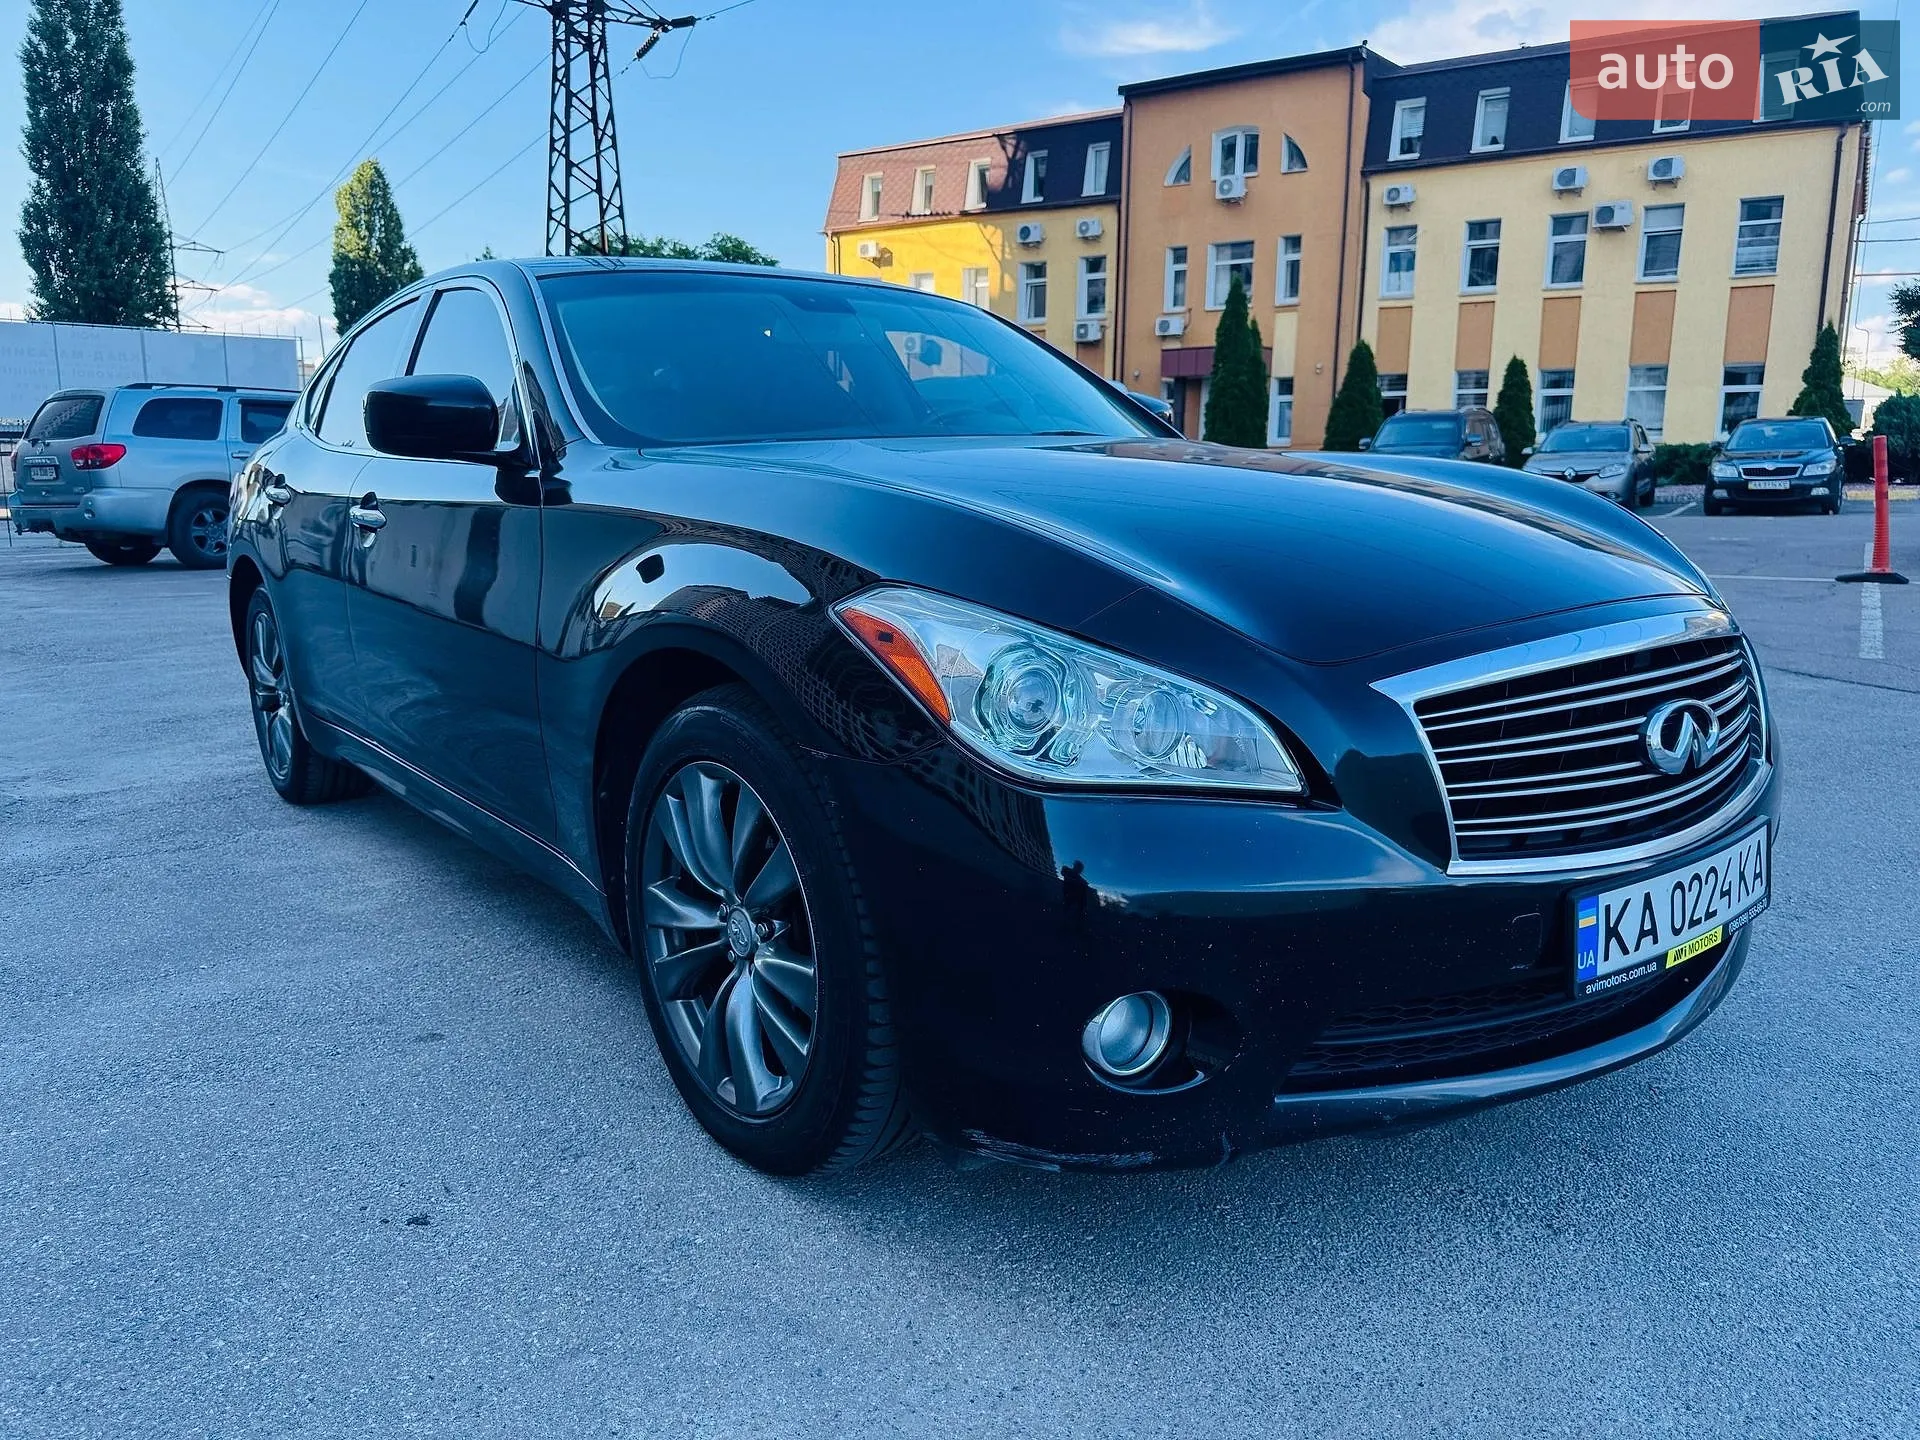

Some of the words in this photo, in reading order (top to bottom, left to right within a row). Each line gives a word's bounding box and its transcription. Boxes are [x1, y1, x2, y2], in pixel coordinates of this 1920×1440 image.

[1603, 891, 1659, 962] KA
[1670, 856, 1732, 937] 0224
[1738, 840, 1764, 903] KA
[1688, 931, 1718, 953] MOTORS
[1577, 949, 1596, 970] UA
[1585, 961, 1657, 994] avimotors.com.ua
